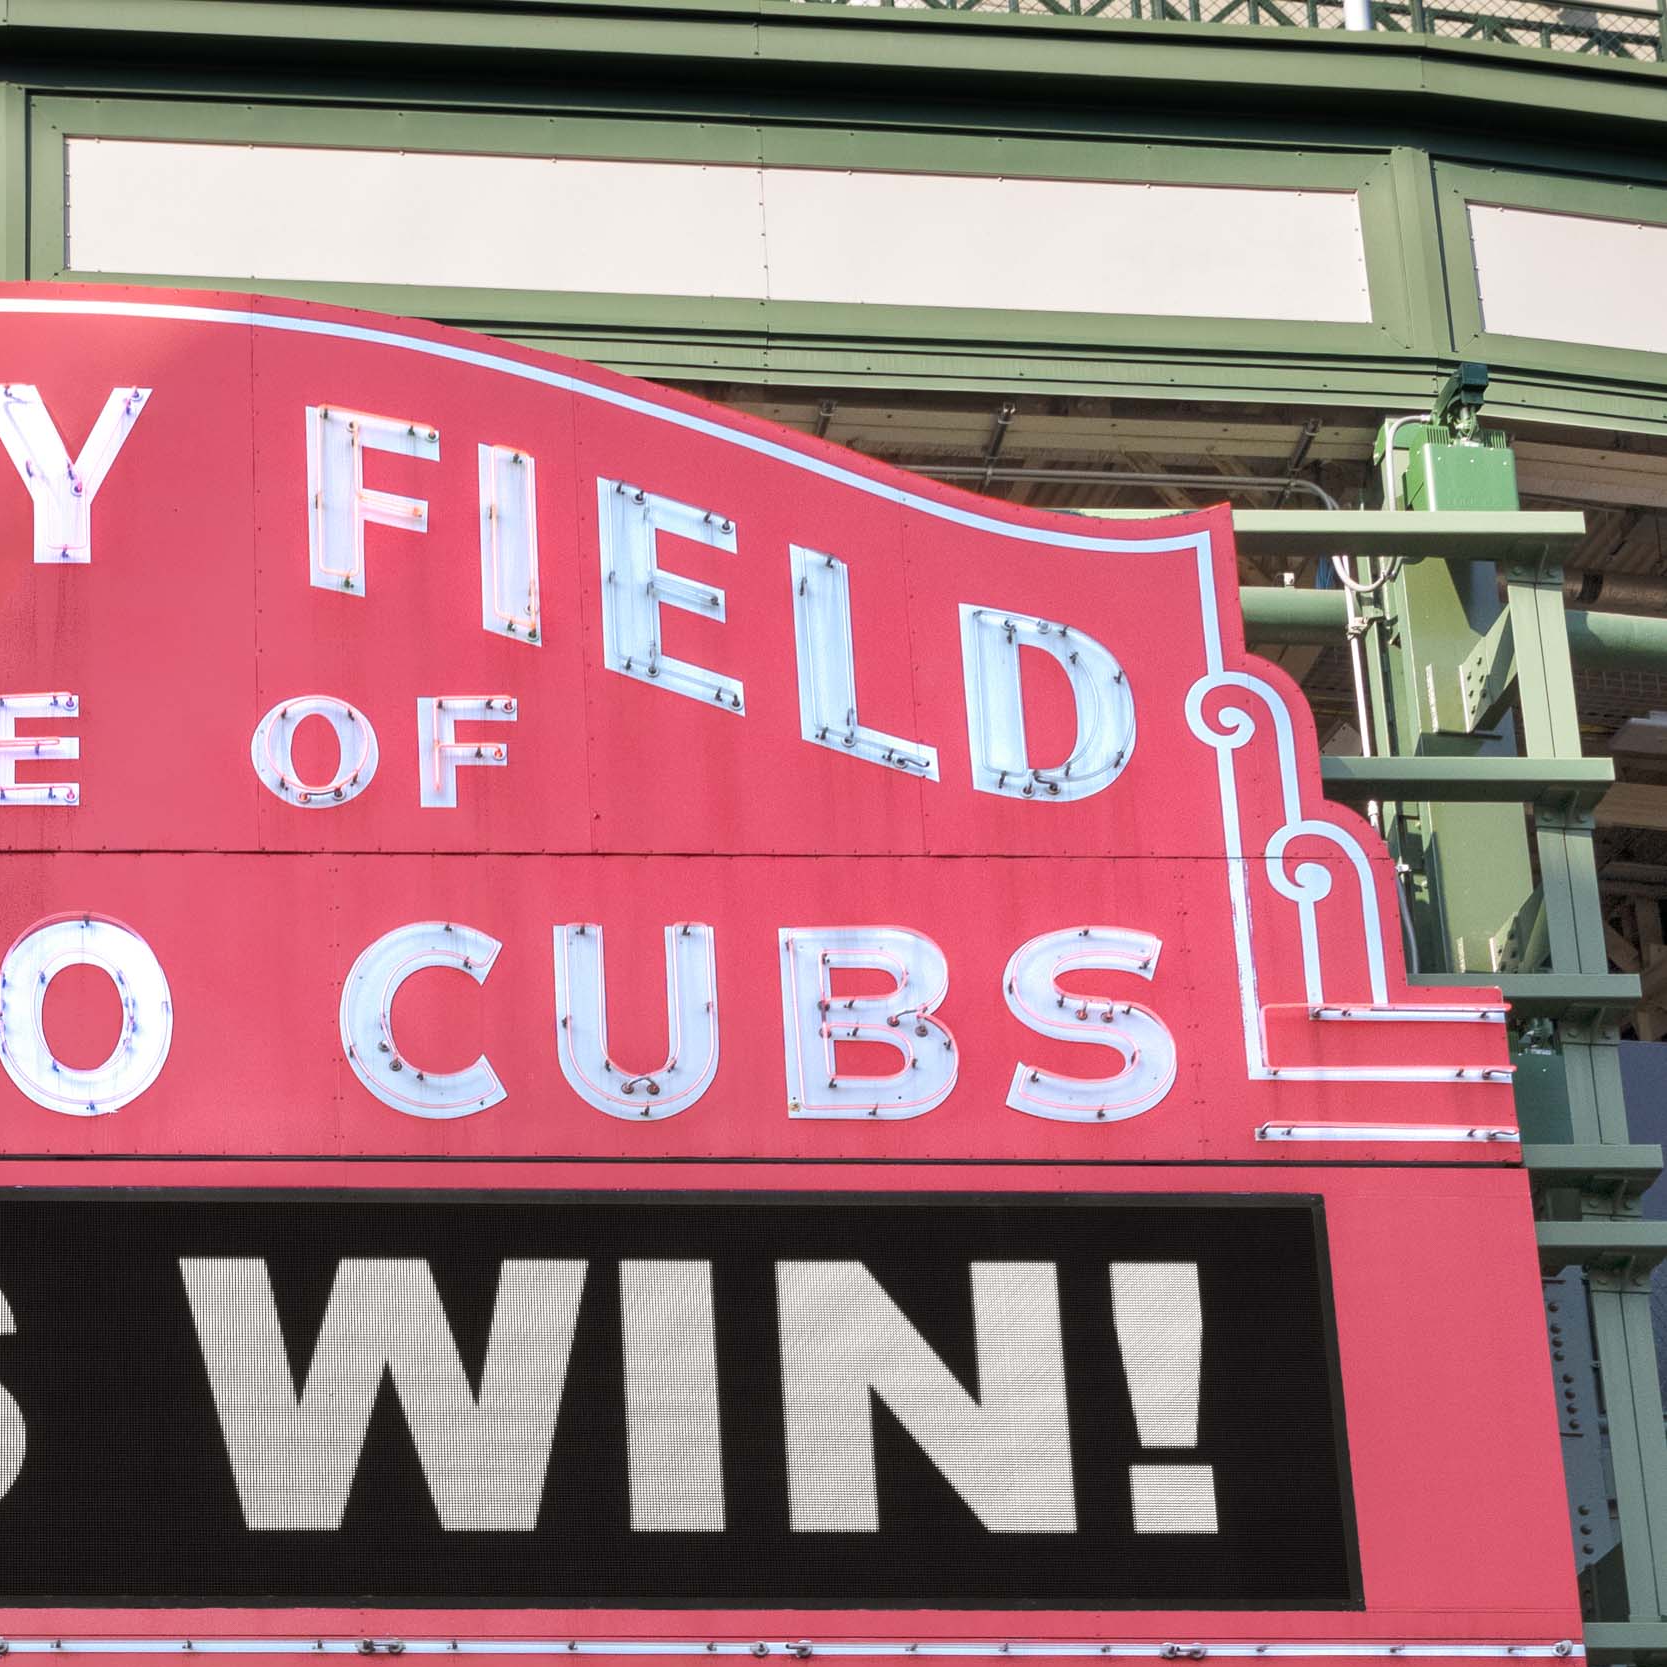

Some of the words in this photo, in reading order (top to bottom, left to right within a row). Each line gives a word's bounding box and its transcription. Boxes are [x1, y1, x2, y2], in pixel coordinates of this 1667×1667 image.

[305, 405, 1138, 804] FIELD
[252, 695, 519, 808] OF
[339, 921, 1178, 1122] CUBS
[178, 1257, 1219, 1535] WIN!
